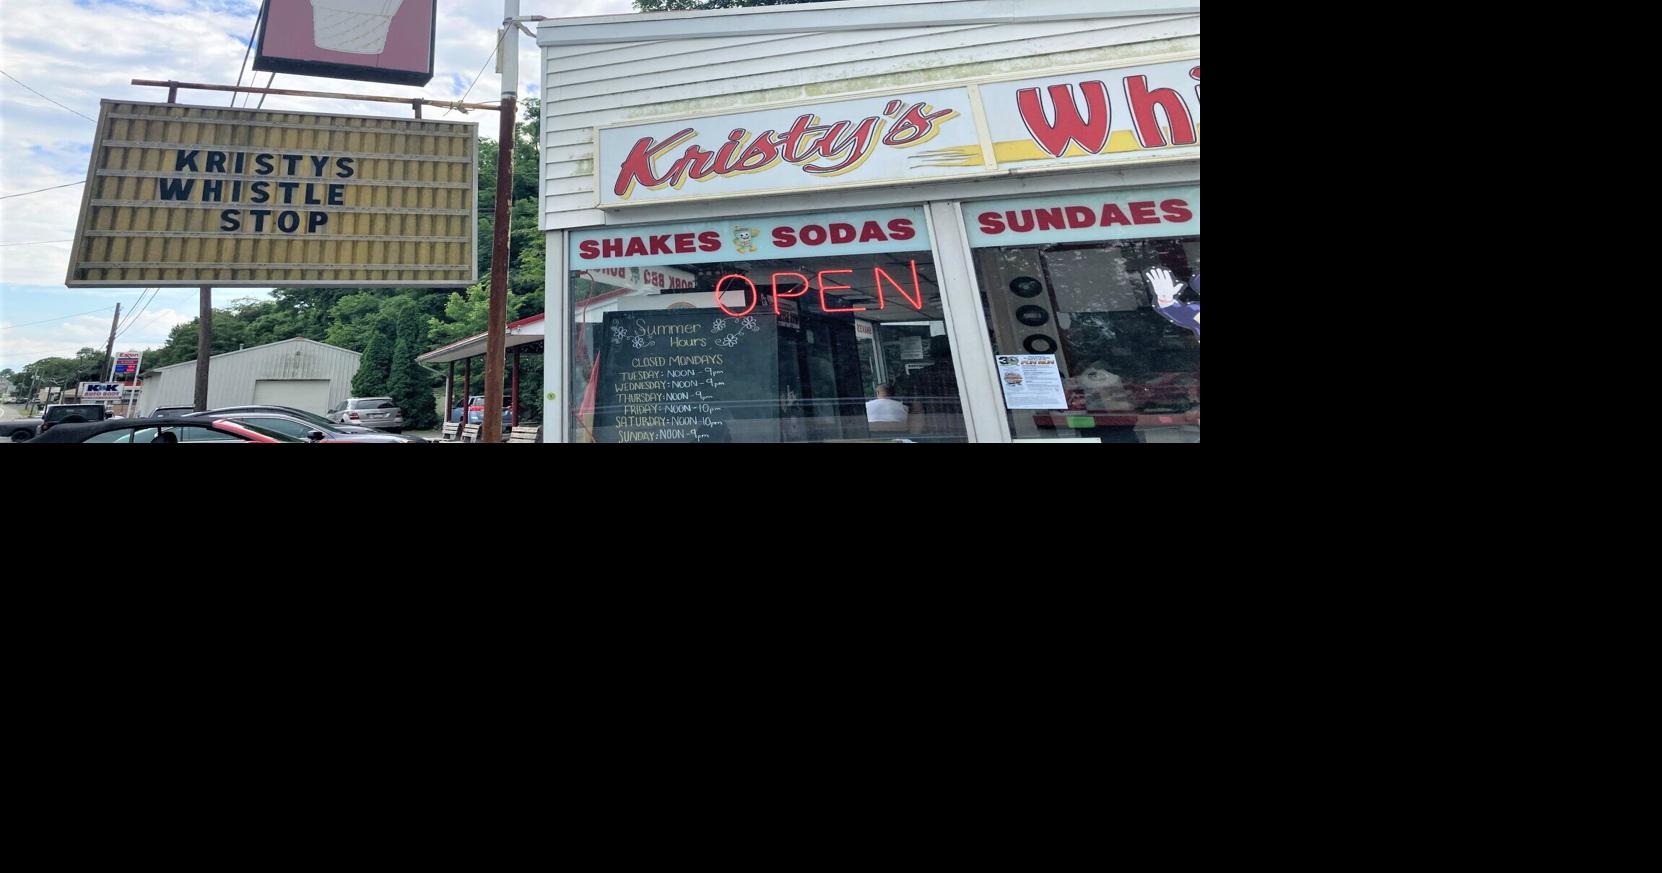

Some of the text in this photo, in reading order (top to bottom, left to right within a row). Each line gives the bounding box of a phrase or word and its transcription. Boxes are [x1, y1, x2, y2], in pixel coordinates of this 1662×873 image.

[614, 65, 1200, 200] Kristy's Wh
[175, 149, 356, 178] KRISTYS
[158, 177, 346, 206] WHISTLE
[220, 208, 329, 234] STOP
[977, 198, 1193, 236] SUNDAES
[578, 218, 916, 260] SHAKES SODAS
[714, 258, 926, 318] OPEN
[634, 318, 702, 337] Summer
[670, 336, 707, 348] Hours
[632, 354, 723, 368] CLOSED MONDAYS
